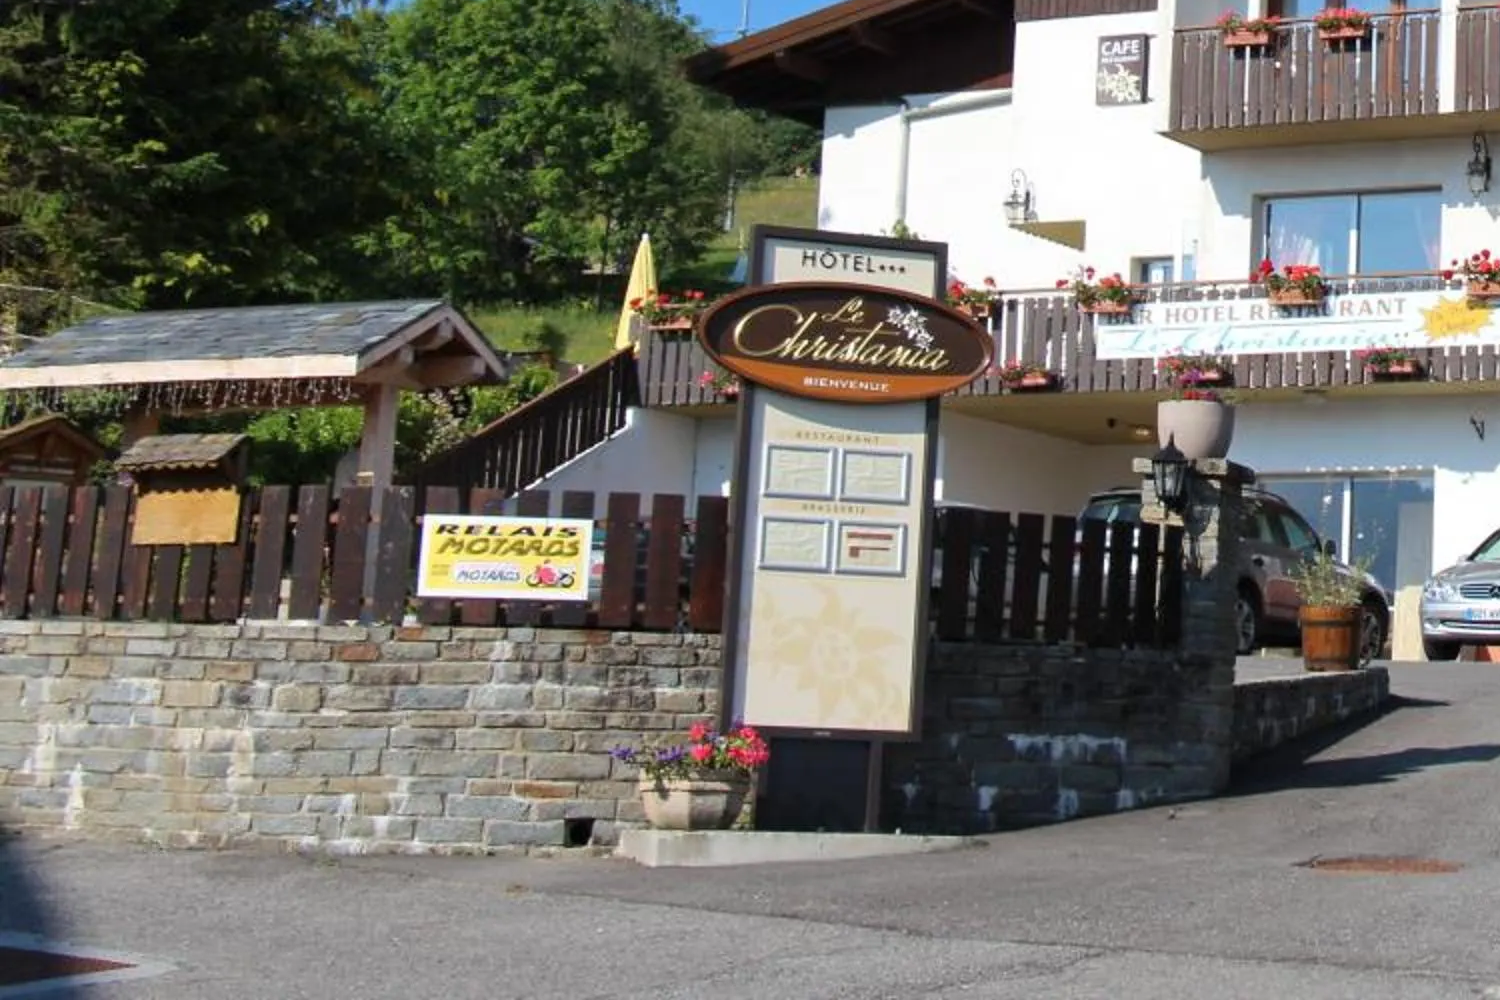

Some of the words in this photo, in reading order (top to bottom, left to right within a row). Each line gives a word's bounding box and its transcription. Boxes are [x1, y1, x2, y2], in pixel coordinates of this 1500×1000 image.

[1101, 39, 1140, 56] CAFE
[801, 249, 876, 274] HÔTEL
[822, 296, 864, 324] Le
[1165, 304, 1240, 324] HOTEL
[1250, 297, 1407, 321] RESTAURANT
[733, 304, 950, 372] Christania
[803, 375, 890, 394] BIENVENUE
[795, 430, 880, 445] RESTAURANT
[436, 523, 577, 538] RELAIS
[436, 537, 580, 558] MOTARDS
